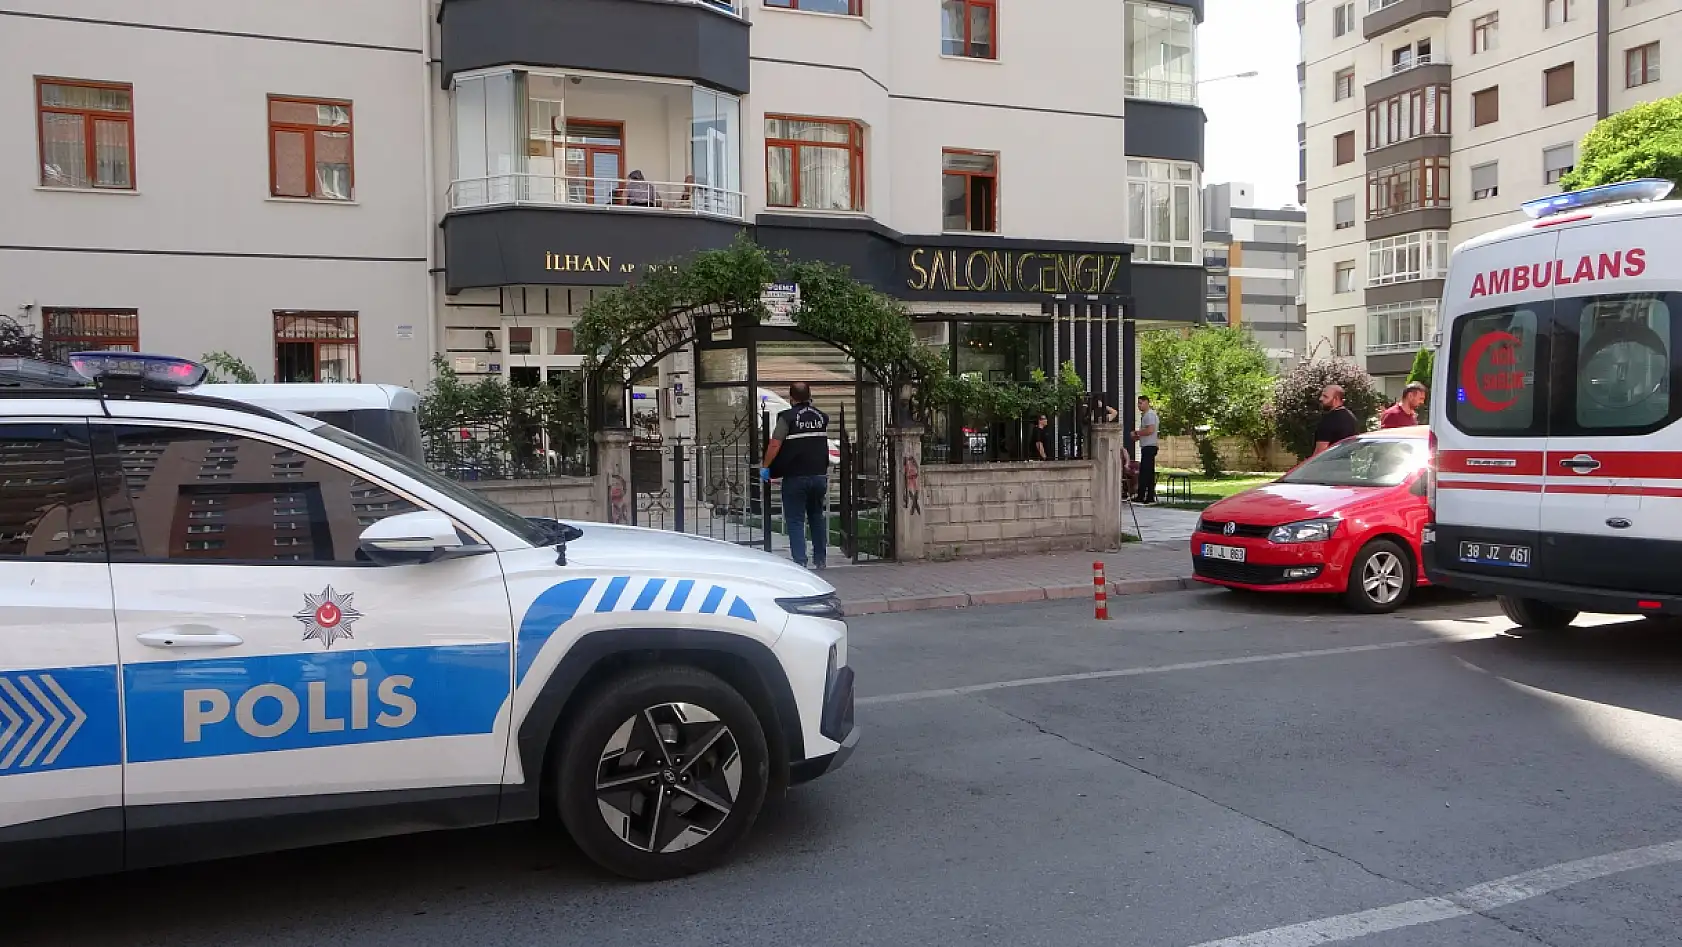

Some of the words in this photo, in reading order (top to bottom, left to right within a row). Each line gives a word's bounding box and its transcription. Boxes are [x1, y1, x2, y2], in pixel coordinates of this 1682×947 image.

[545, 250, 612, 272] İLHAN
[907, 248, 1012, 292] SALON
[1469, 248, 1647, 299] AMBULANS
[1467, 544, 1481, 559] 38
[1486, 546, 1500, 560] JZ
[1510, 547, 1529, 563] 461
[183, 660, 417, 743] POLİS
